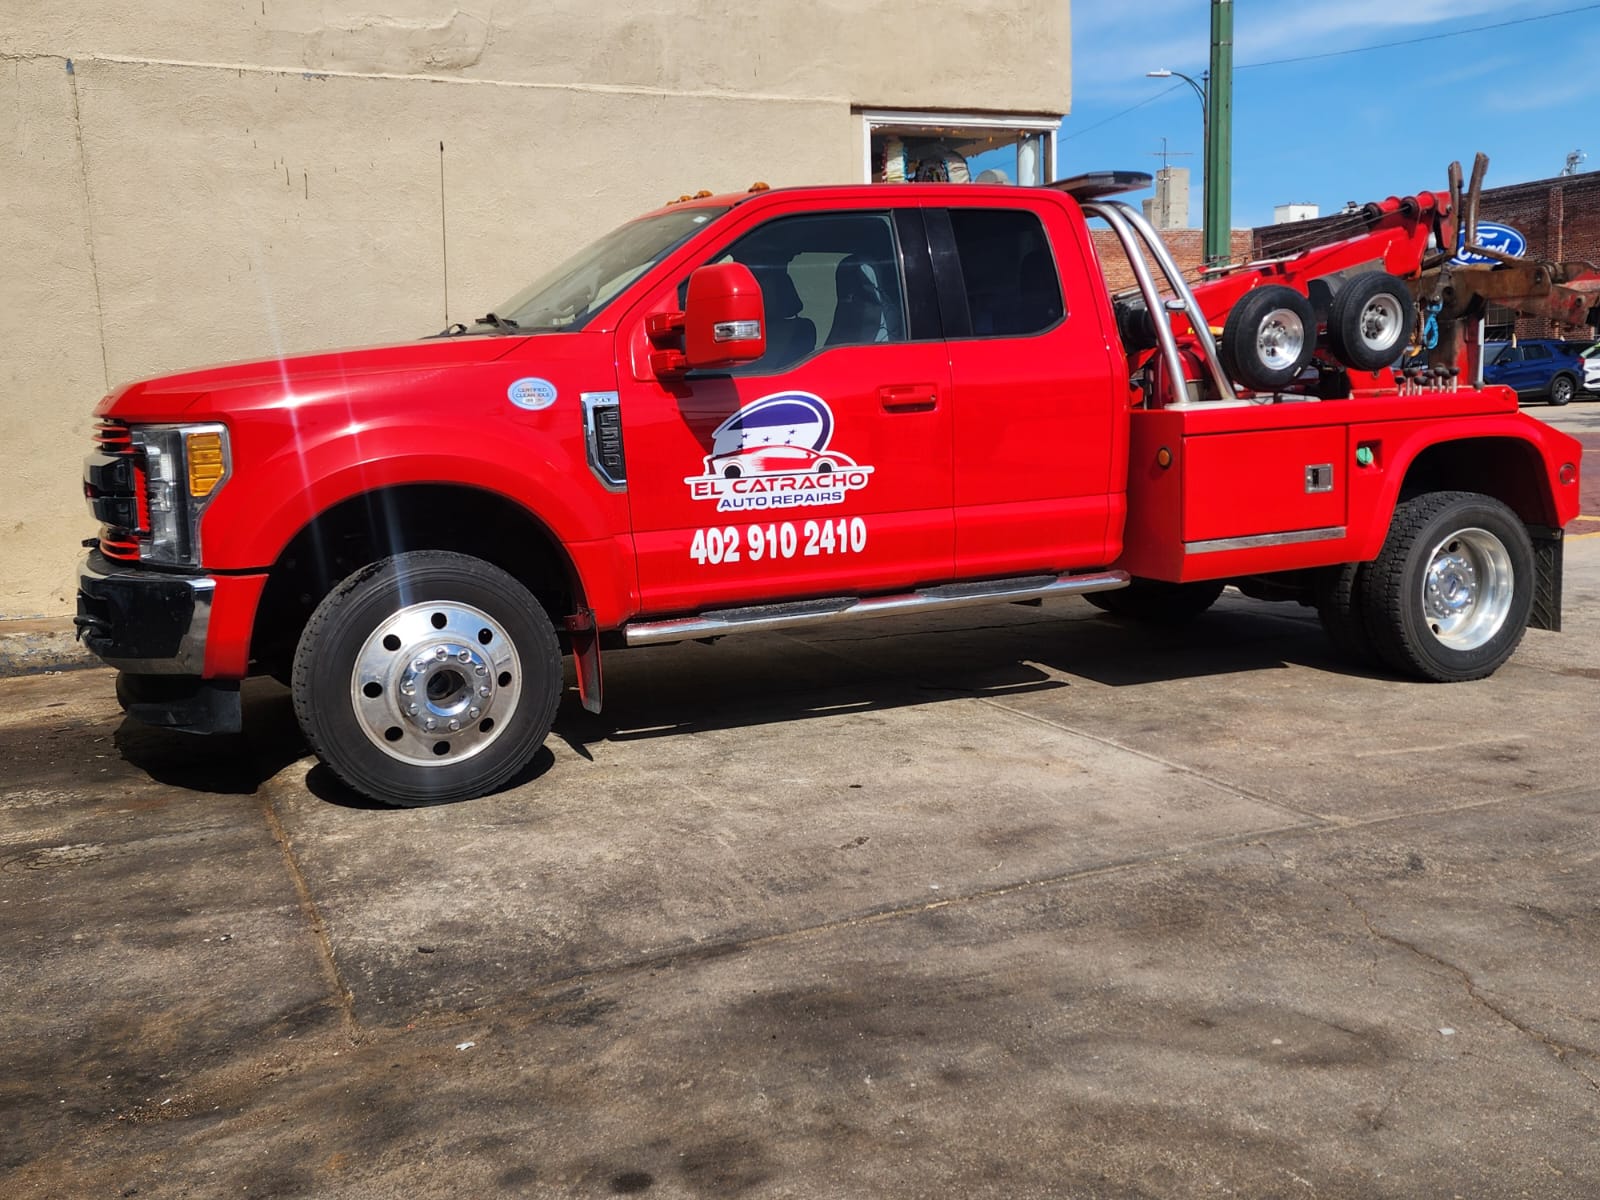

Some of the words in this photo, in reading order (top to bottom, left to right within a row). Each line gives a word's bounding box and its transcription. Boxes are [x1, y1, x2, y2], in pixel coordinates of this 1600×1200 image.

[694, 482, 723, 497] EL
[732, 472, 865, 494] CATRACHO
[720, 495, 767, 509] AUTO
[771, 491, 842, 505] REPAIRS
[690, 526, 740, 565] 402
[747, 522, 797, 561] 910
[803, 517, 867, 556] 2410
